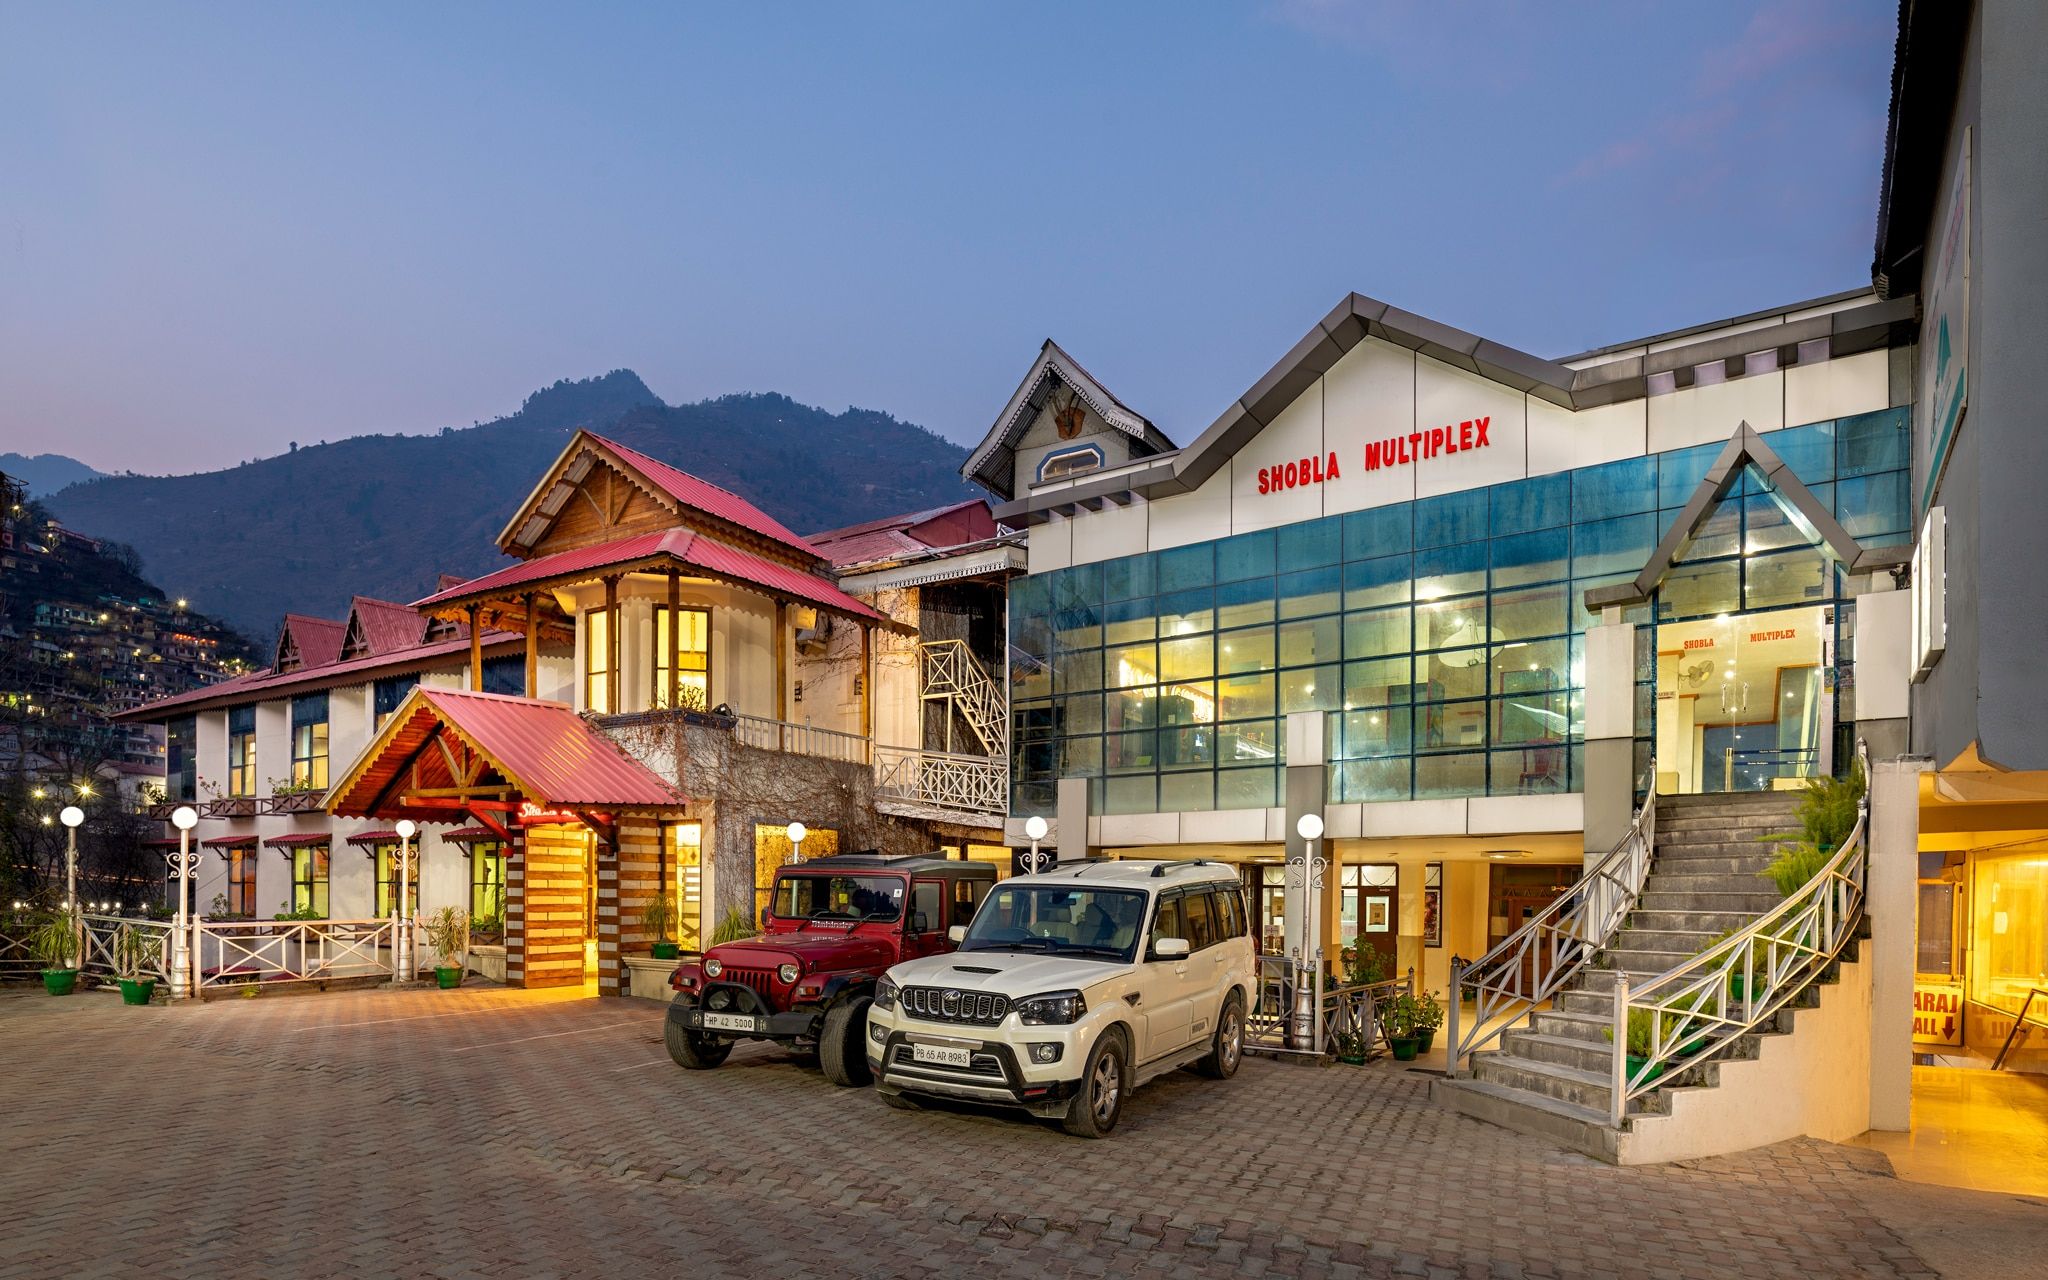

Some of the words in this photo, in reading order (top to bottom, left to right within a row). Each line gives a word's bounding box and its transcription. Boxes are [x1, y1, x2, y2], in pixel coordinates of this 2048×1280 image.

[1258, 451, 1340, 495] SHOBLA
[1364, 416, 1491, 472] MULTIPLEX
[1684, 638, 1714, 650] SHOBLA
[1750, 629, 1796, 642] MULTIPLEX
[709, 1016, 718, 1025] HP
[734, 1018, 753, 1029] 5000
[916, 1048, 925, 1059] PB
[926, 1049, 936, 1060] 65
[937, 1051, 947, 1061] AR
[948, 1052, 967, 1064] 8983
